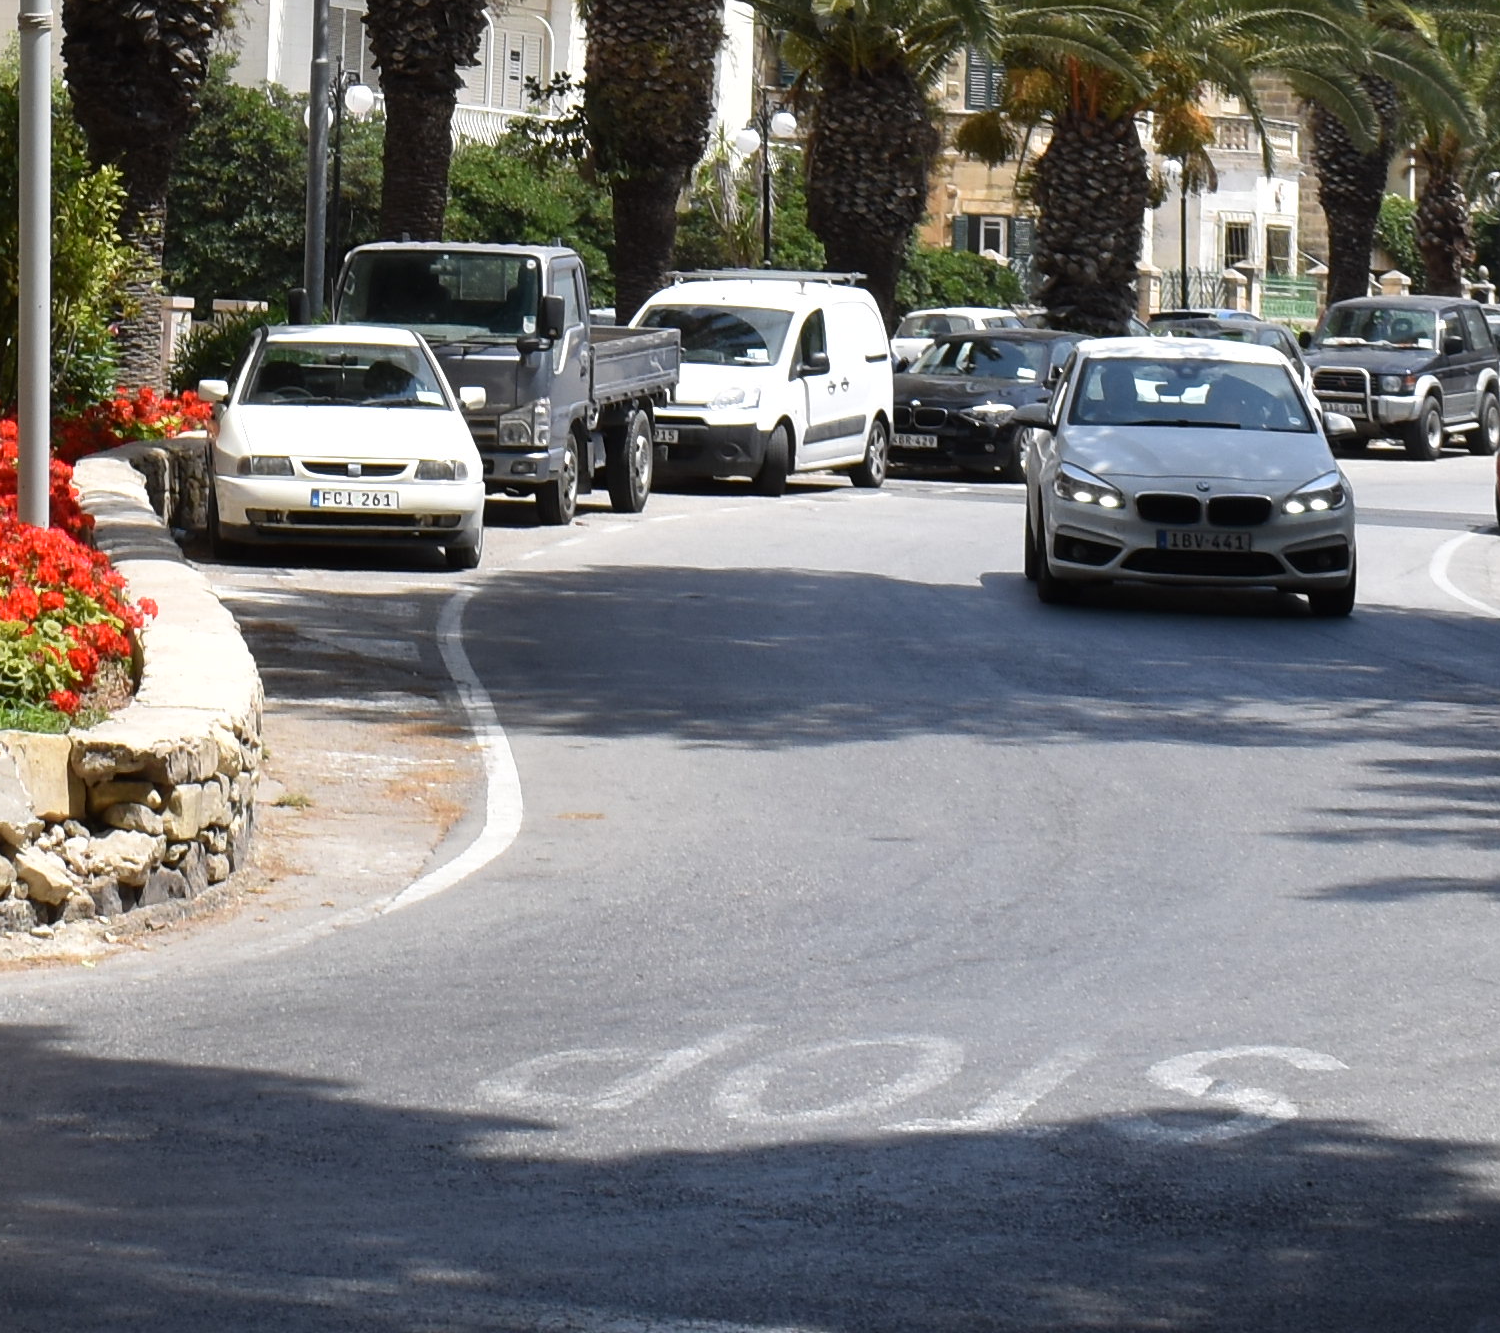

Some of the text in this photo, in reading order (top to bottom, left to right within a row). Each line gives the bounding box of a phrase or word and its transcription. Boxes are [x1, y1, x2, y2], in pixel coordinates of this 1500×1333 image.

[322, 491, 392, 507] FCI 261
[1170, 532, 1245, 551] IBV 441
[474, 1023, 1350, 1142] STOP
